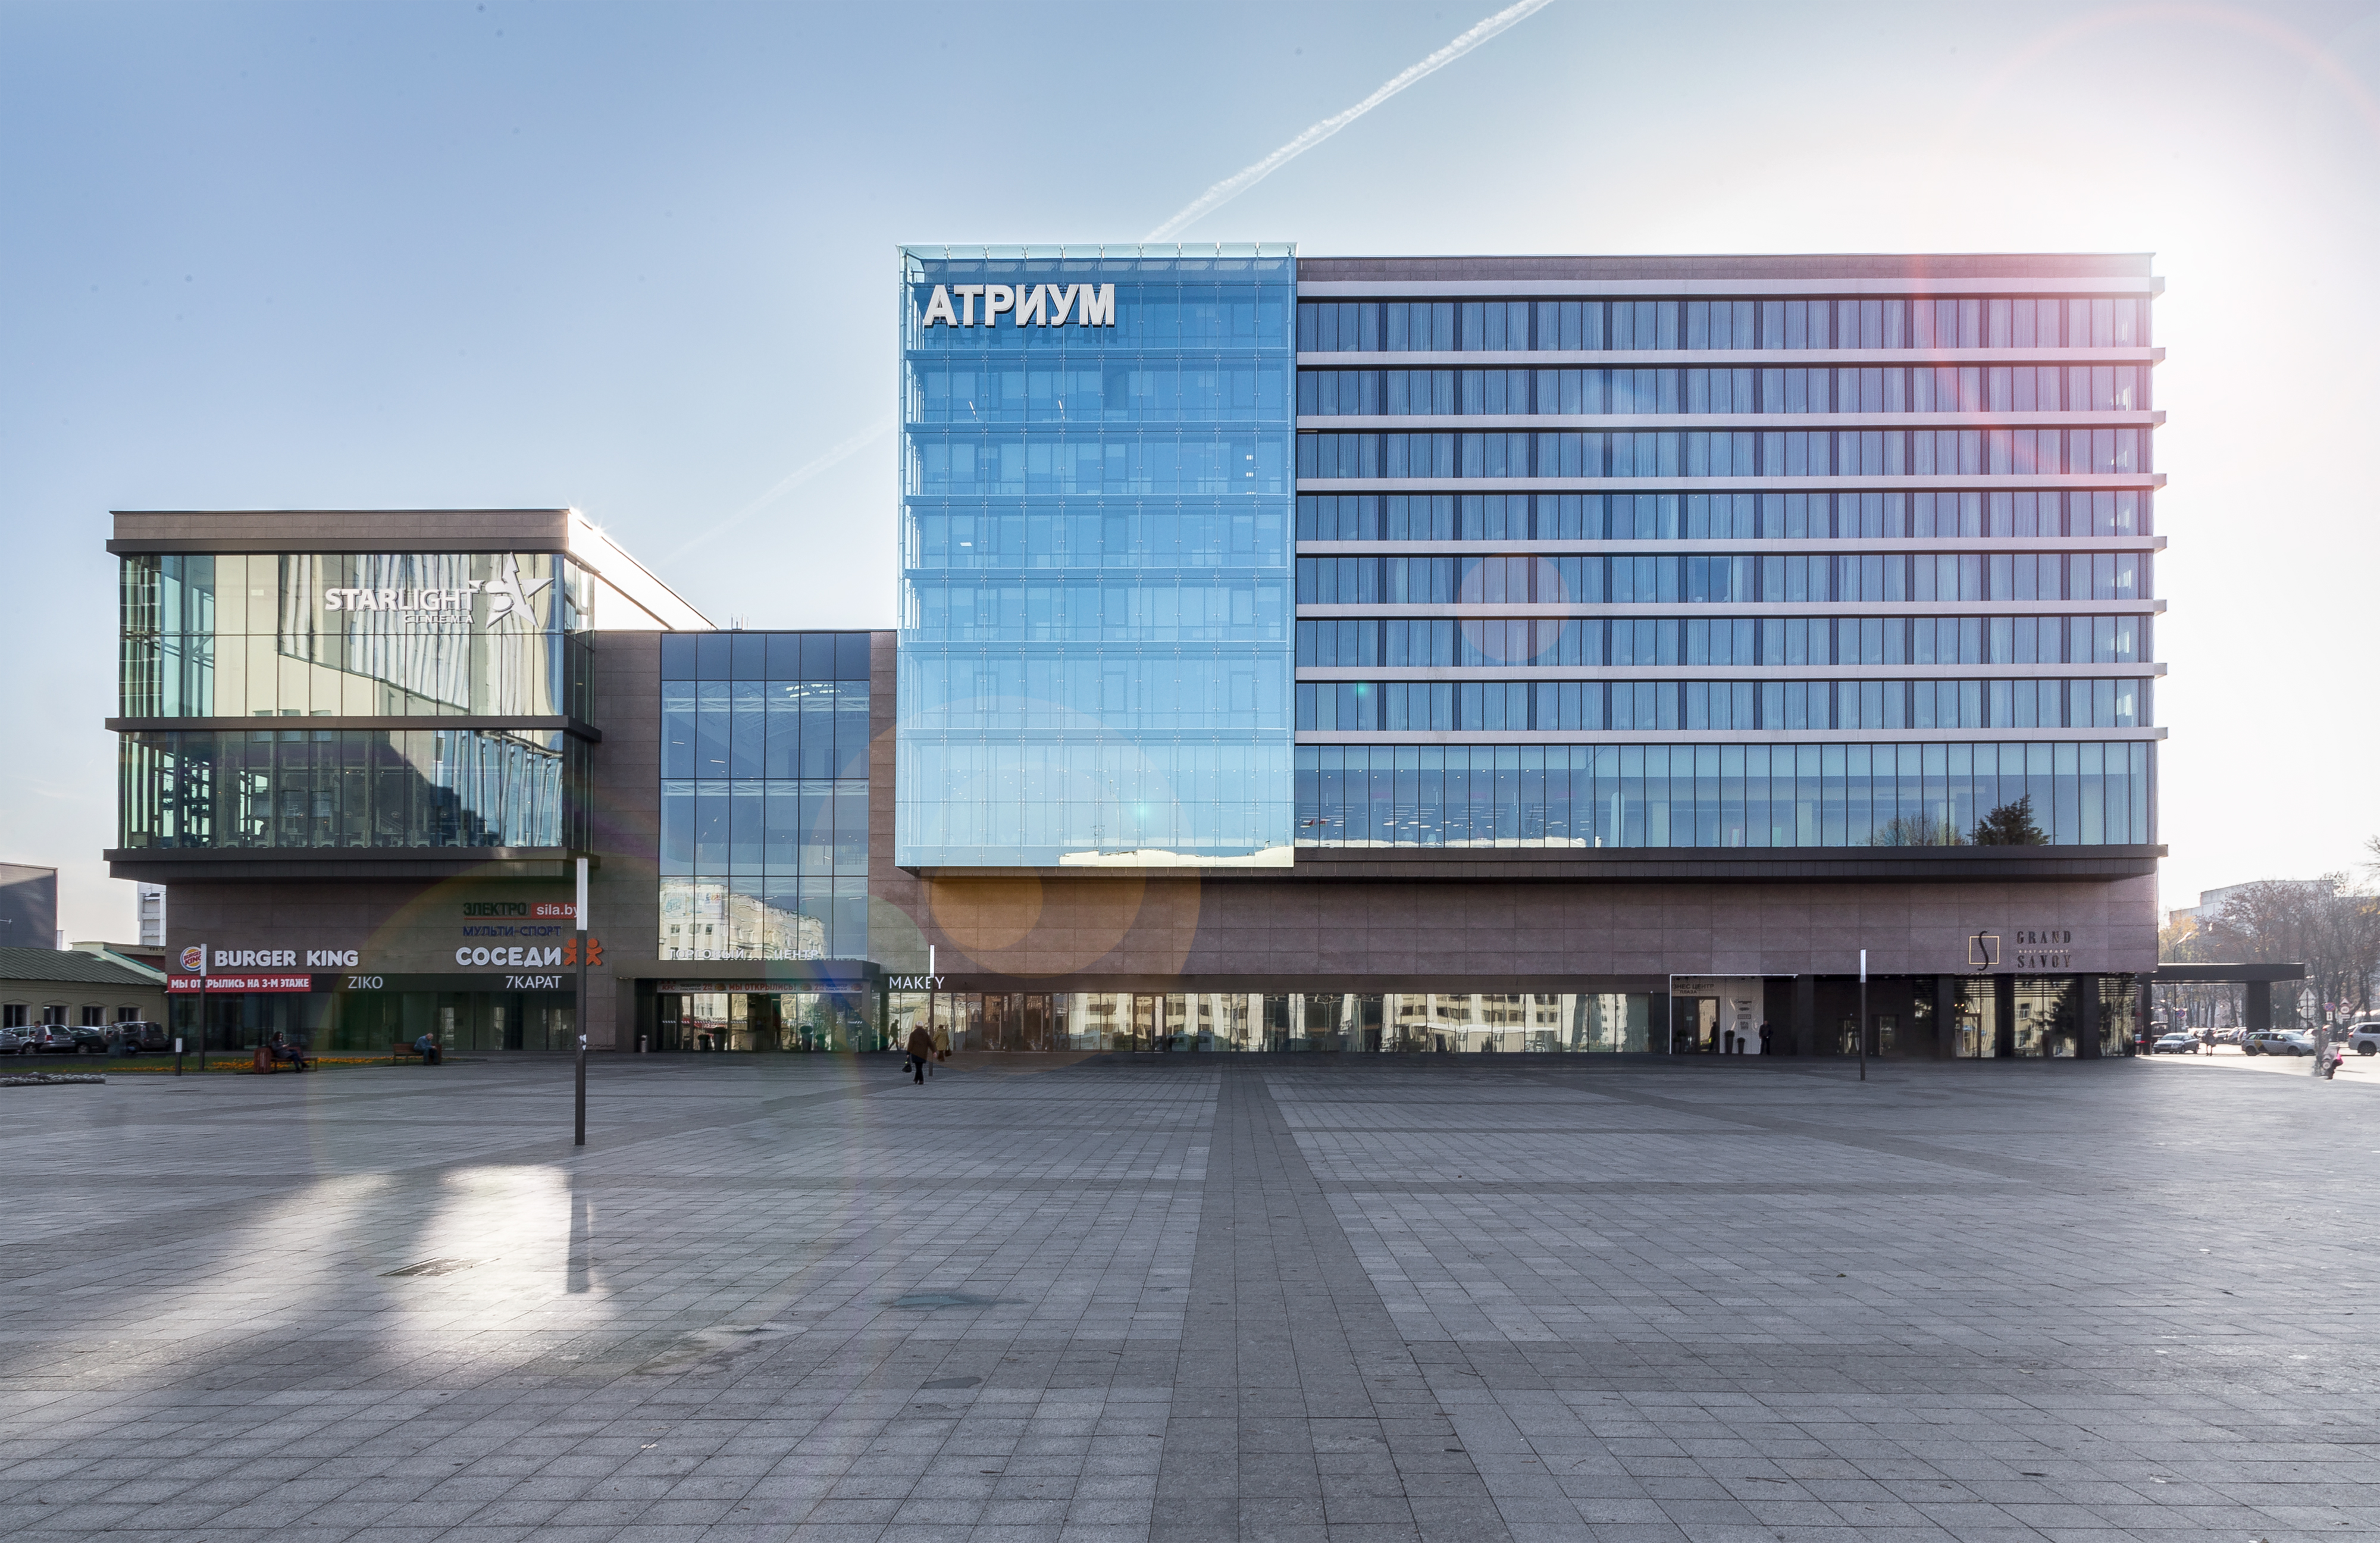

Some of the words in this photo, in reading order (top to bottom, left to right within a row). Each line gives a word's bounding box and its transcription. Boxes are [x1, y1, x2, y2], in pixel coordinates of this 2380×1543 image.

[923, 284, 1115, 327] АТРИУМ
[325, 588, 480, 611] STARLIGHT
[403, 615, 474, 624] CINEMA
[464, 902, 527, 916] ЭЛЕКТРО
[463, 925, 562, 937] МУЛЬТИ-СПОРТ
[2017, 931, 2071, 944] GRAND
[215, 950, 296, 966] BURGER
[307, 950, 358, 966] KING
[456, 947, 561, 967] СОСЕДИ
[668, 947, 744, 959] ТОРГОВЫЙ
[775, 949, 819, 960] ЦЕНТР
[2018, 955, 2071, 968] SAVOY
[171, 979, 188, 988] МЫ
[190, 979, 245, 988] ОТРЫЛИСЬ
[247, 979, 259, 988] НА
[262, 979, 278, 988] 3-М
[280, 979, 309, 988] ЭТАЖЕ
[348, 976, 383, 989] ZIKO
[506, 976, 562, 988] 7КАРАТ
[890, 976, 945, 989] MAKEY
